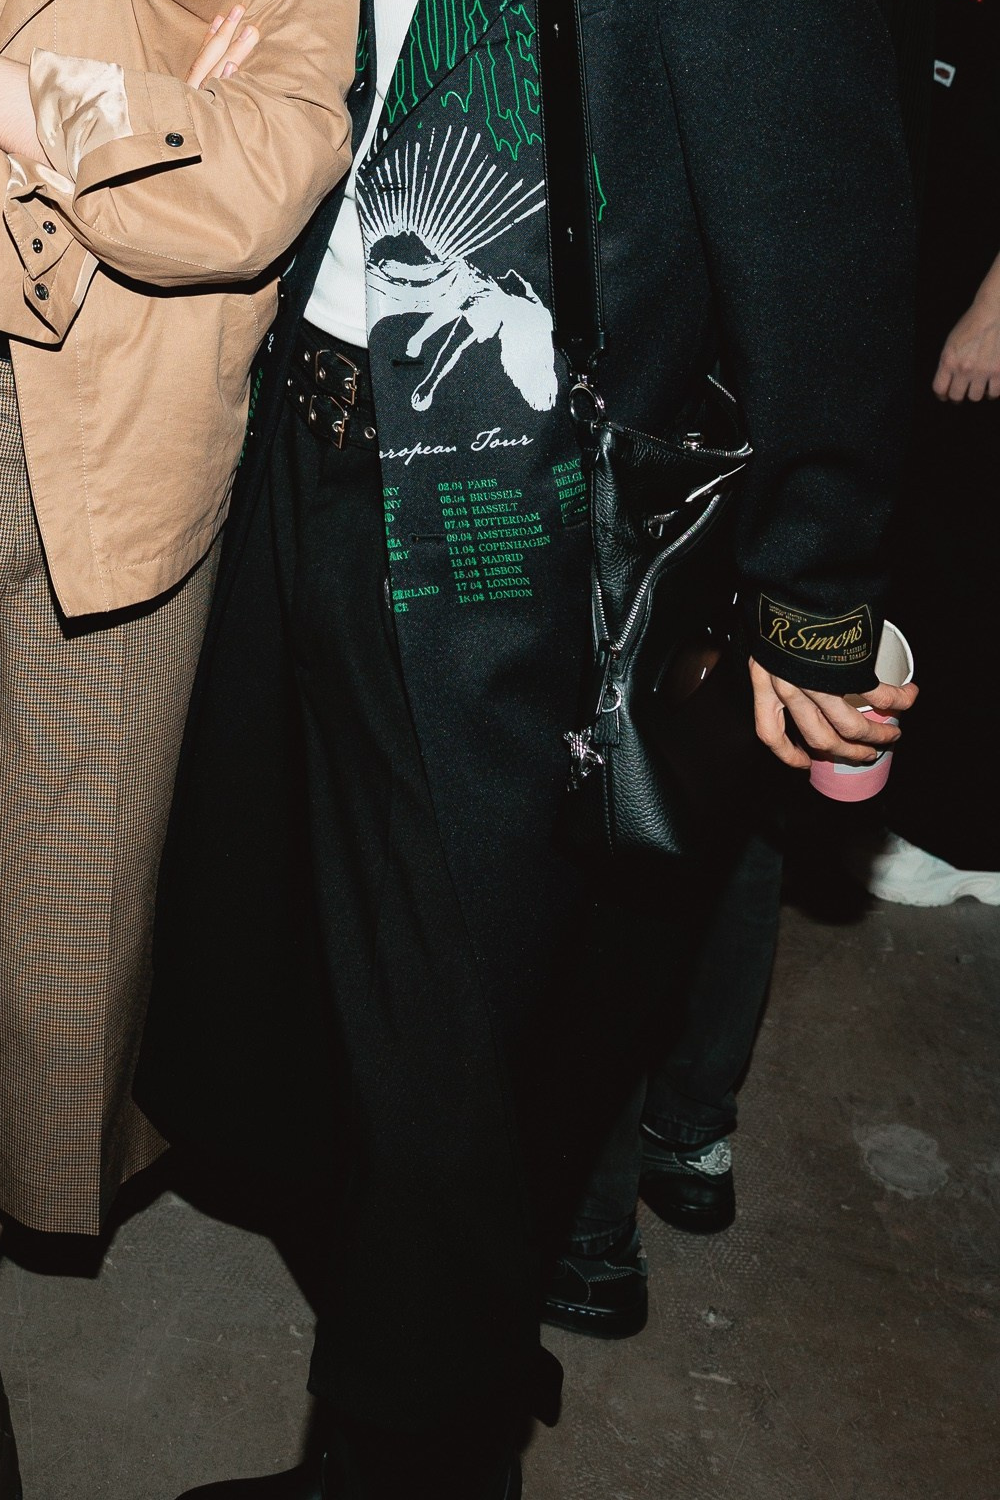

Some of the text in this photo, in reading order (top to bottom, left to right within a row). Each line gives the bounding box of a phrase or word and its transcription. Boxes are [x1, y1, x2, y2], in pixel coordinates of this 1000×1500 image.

[470, 426, 534, 451] Tour
[551, 458, 581, 475] FRANC
[467, 478, 498, 490] PARIS
[555, 470, 584, 488] BELGI
[469, 489, 523, 503] BRUSSELS
[471, 502, 518, 515] HASSELT
[473, 512, 541, 528] ROTTERDAM
[476, 524, 543, 540] AMSTERDAM
[478, 535, 551, 552] COPENHAGEN
[481, 553, 524, 565] MADRID
[483, 565, 523, 577] LISBON
[486, 576, 531, 588] LONDON
[488, 588, 533, 600] LONDON
